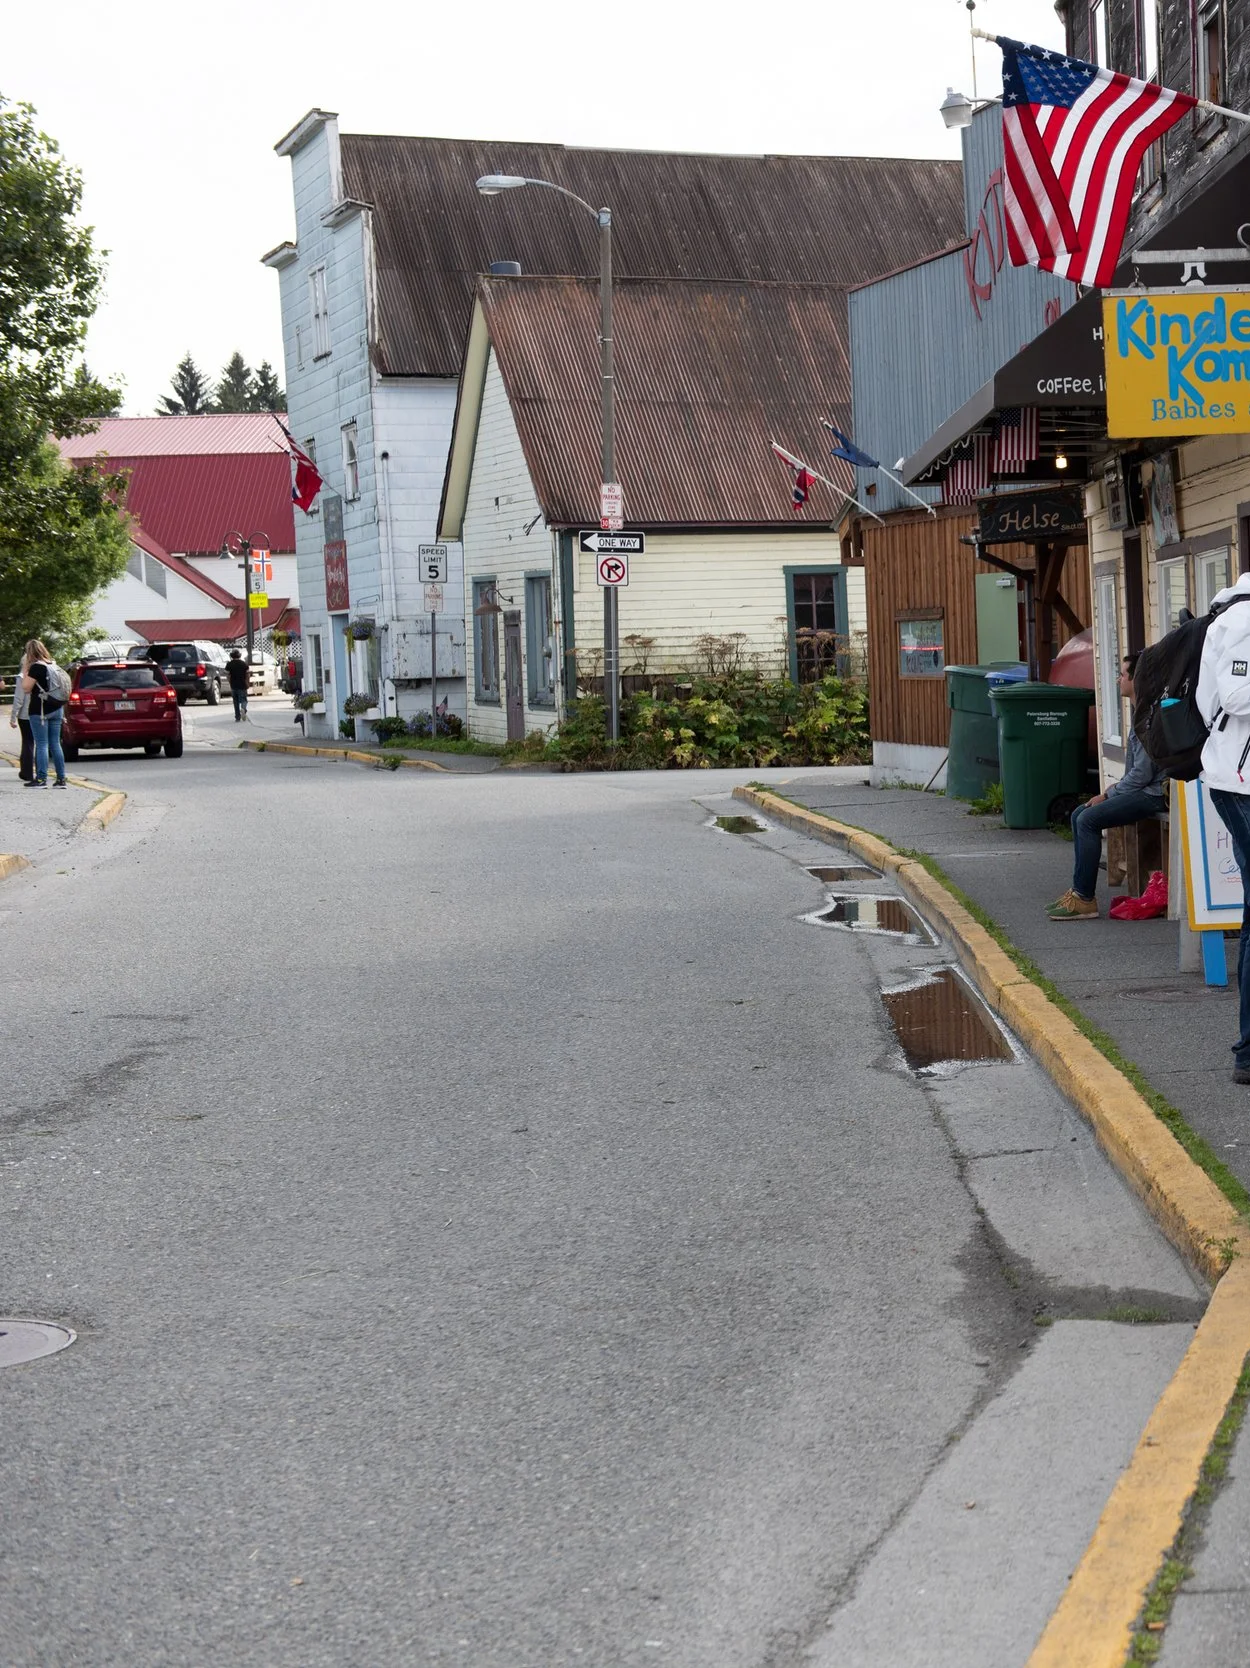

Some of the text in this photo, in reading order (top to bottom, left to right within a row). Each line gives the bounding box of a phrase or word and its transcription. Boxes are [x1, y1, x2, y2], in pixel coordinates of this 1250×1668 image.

[1151, 399, 1236, 421] Babies
[999, 504, 1060, 533] Helse
[599, 538, 637, 547] ONE WAY
[428, 565, 439, 579] 5
[255, 582, 261, 590] 5
[1234, 662, 1247, 671] HH
